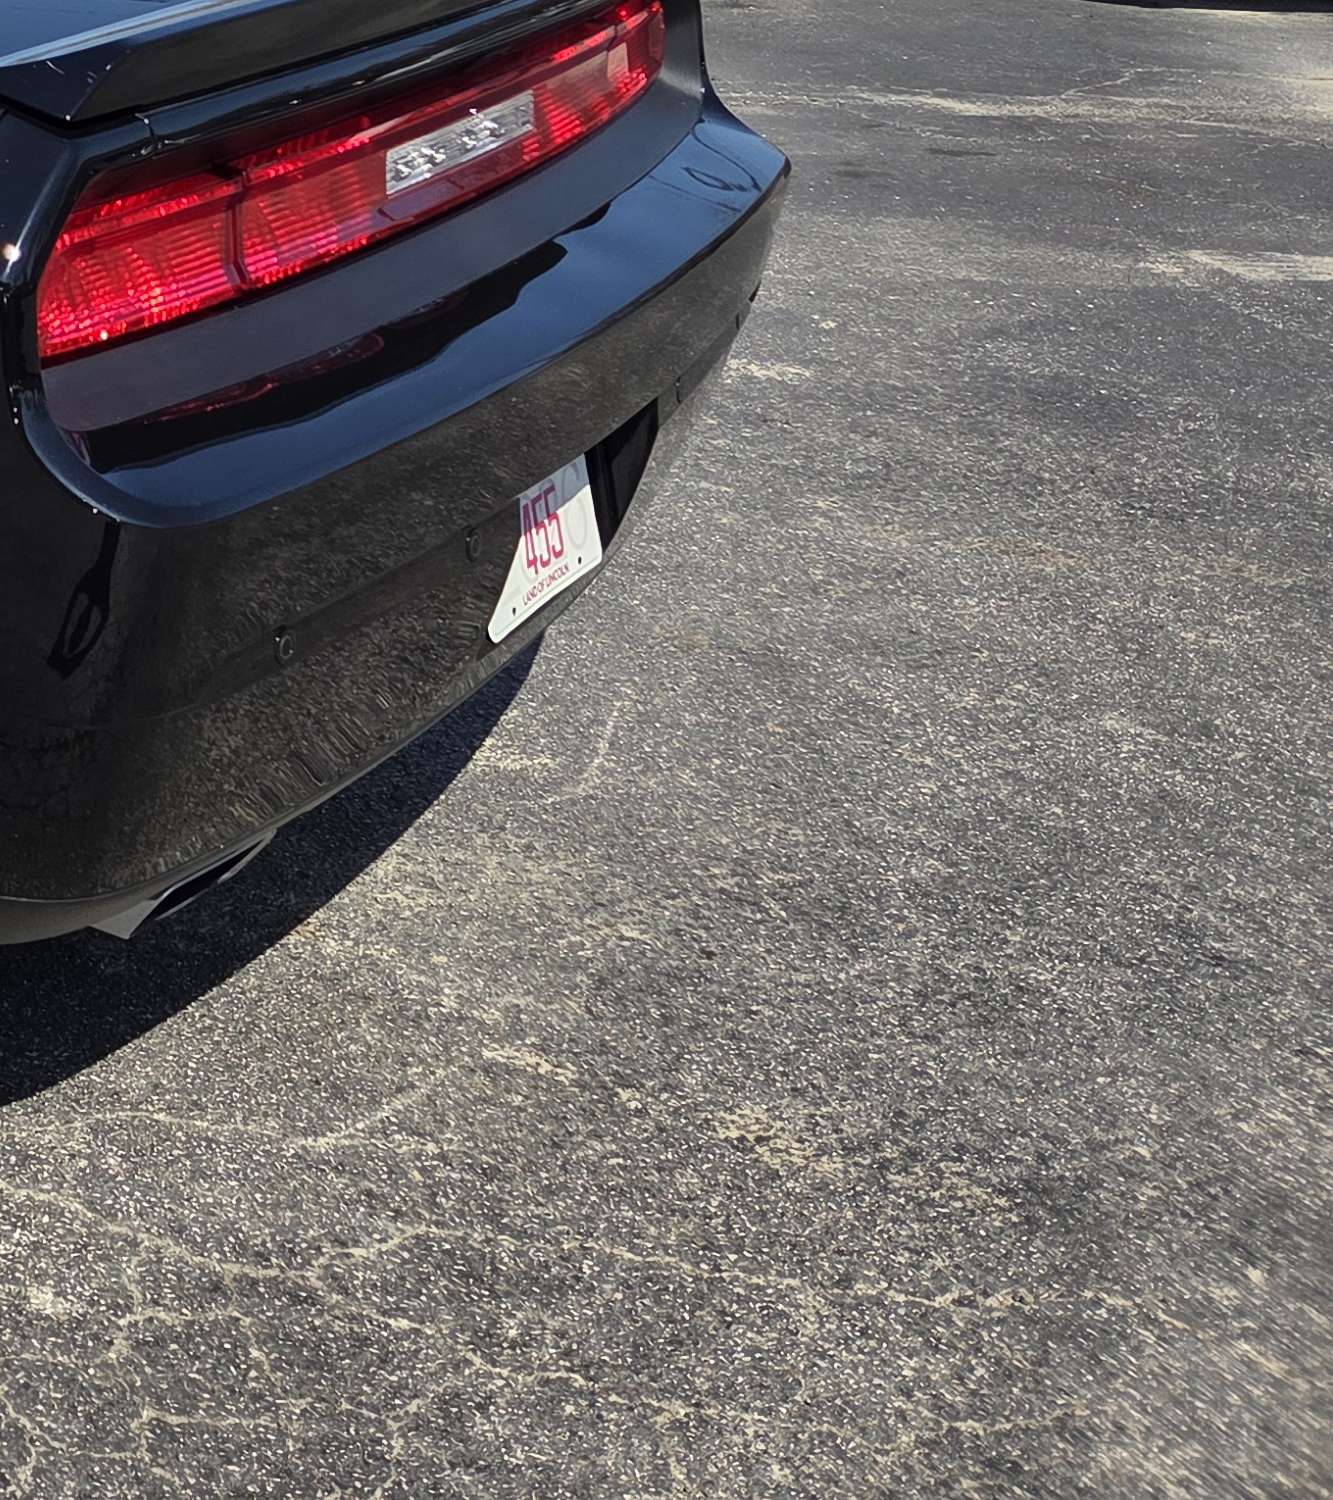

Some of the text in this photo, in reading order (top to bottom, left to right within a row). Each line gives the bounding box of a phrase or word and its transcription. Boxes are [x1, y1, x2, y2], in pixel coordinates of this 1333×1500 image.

[522, 484, 565, 575] 455
[522, 585, 539, 606] LAND
[543, 562, 570, 590] LINCOLN
